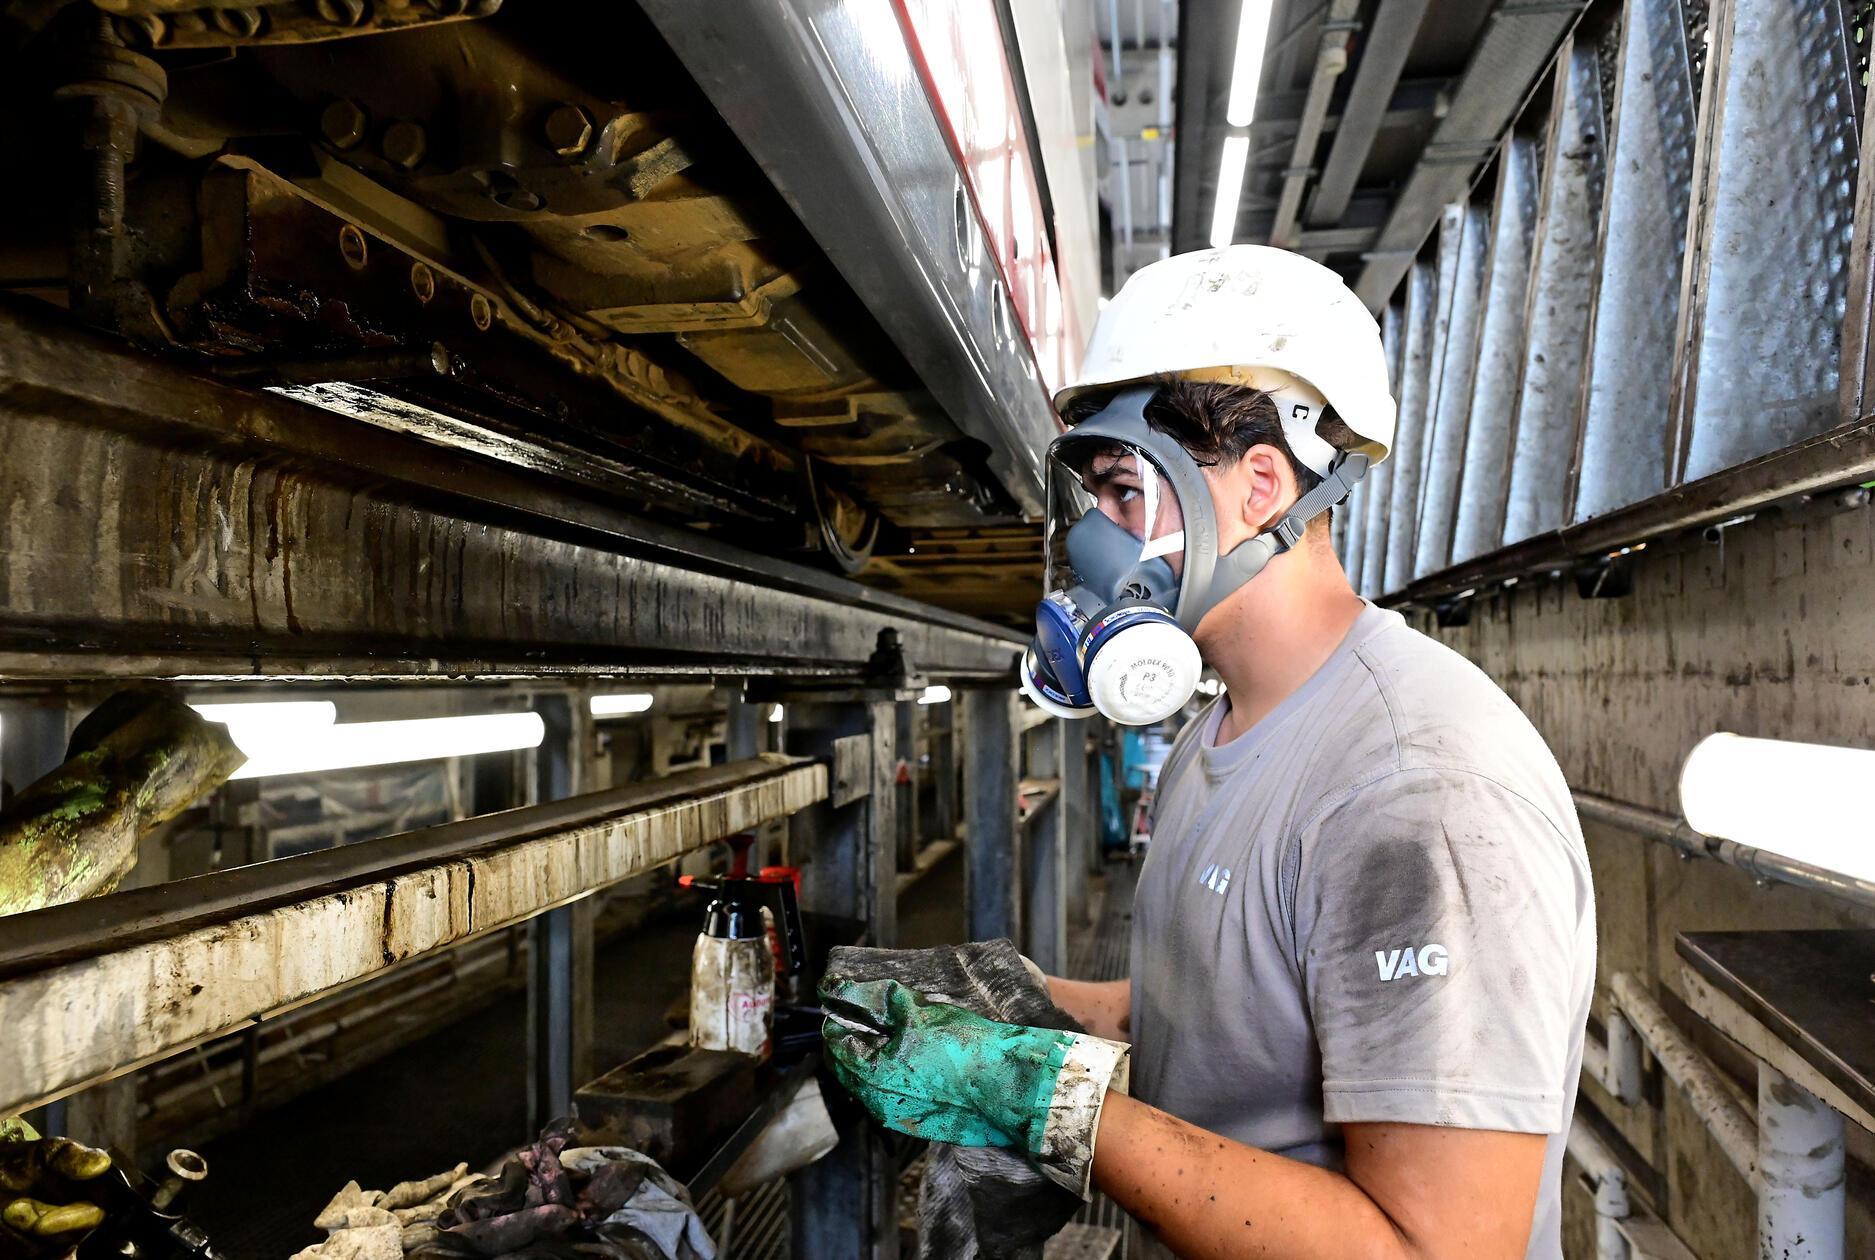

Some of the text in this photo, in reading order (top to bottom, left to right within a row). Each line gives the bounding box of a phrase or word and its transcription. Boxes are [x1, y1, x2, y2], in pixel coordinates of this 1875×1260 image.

[1130, 658, 1162, 670] MOLDEX
[1142, 672, 1157, 682] P3
[1375, 944, 1448, 981] VAG
